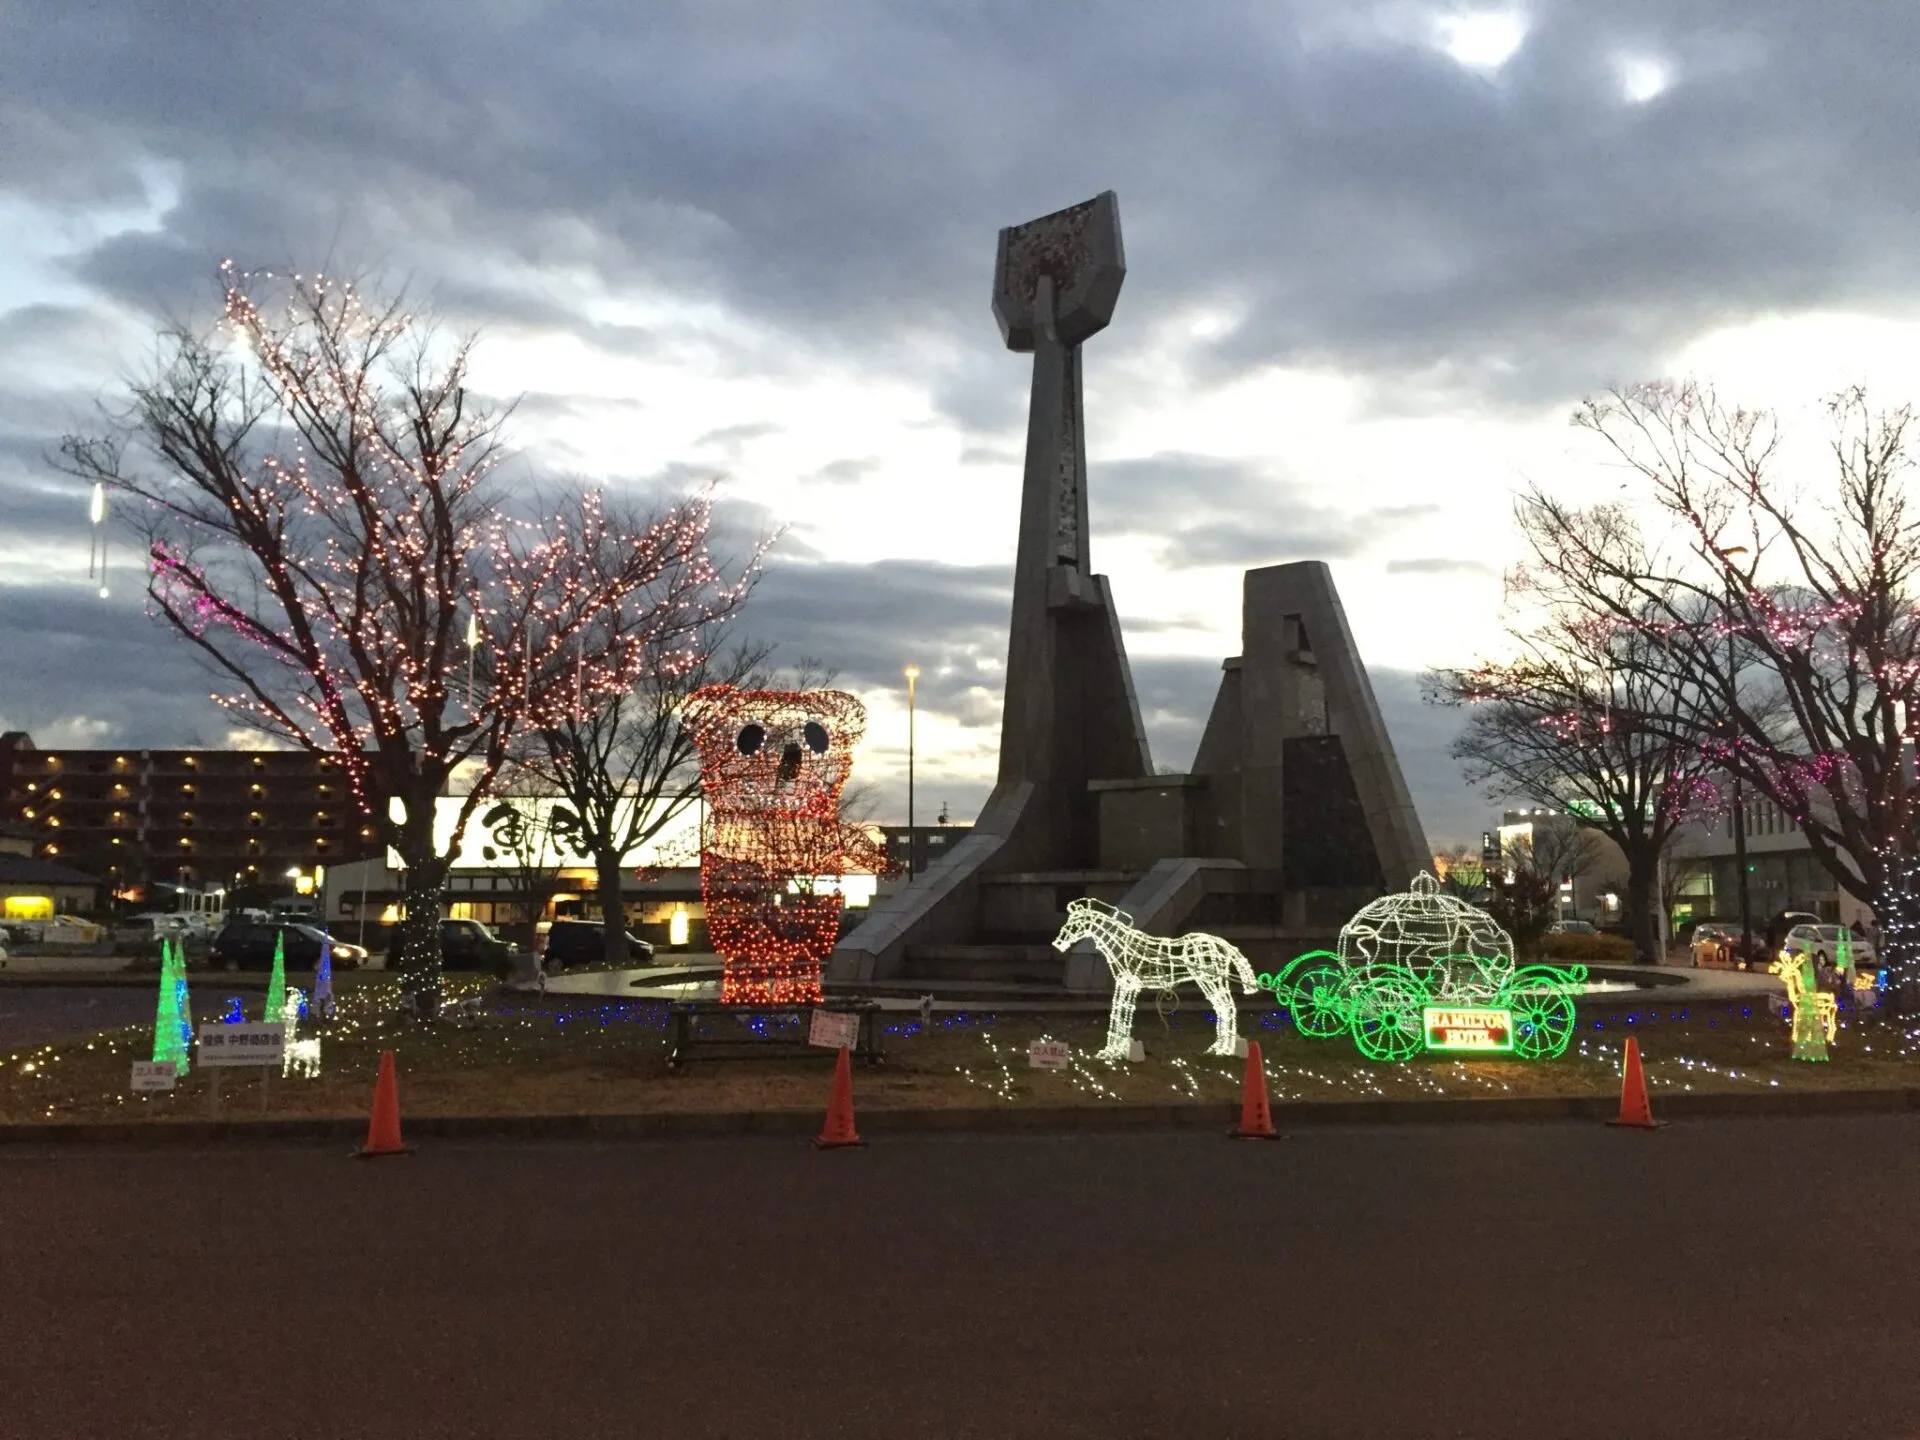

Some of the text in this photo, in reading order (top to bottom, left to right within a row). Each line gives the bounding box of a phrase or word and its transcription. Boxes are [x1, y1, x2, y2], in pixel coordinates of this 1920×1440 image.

[482, 803, 591, 860] 魚民
[1430, 1012, 1508, 1028] HAMILTON
[228, 1033, 281, 1046] 中野商店会
[1446, 1029, 1495, 1044] HOTEL
